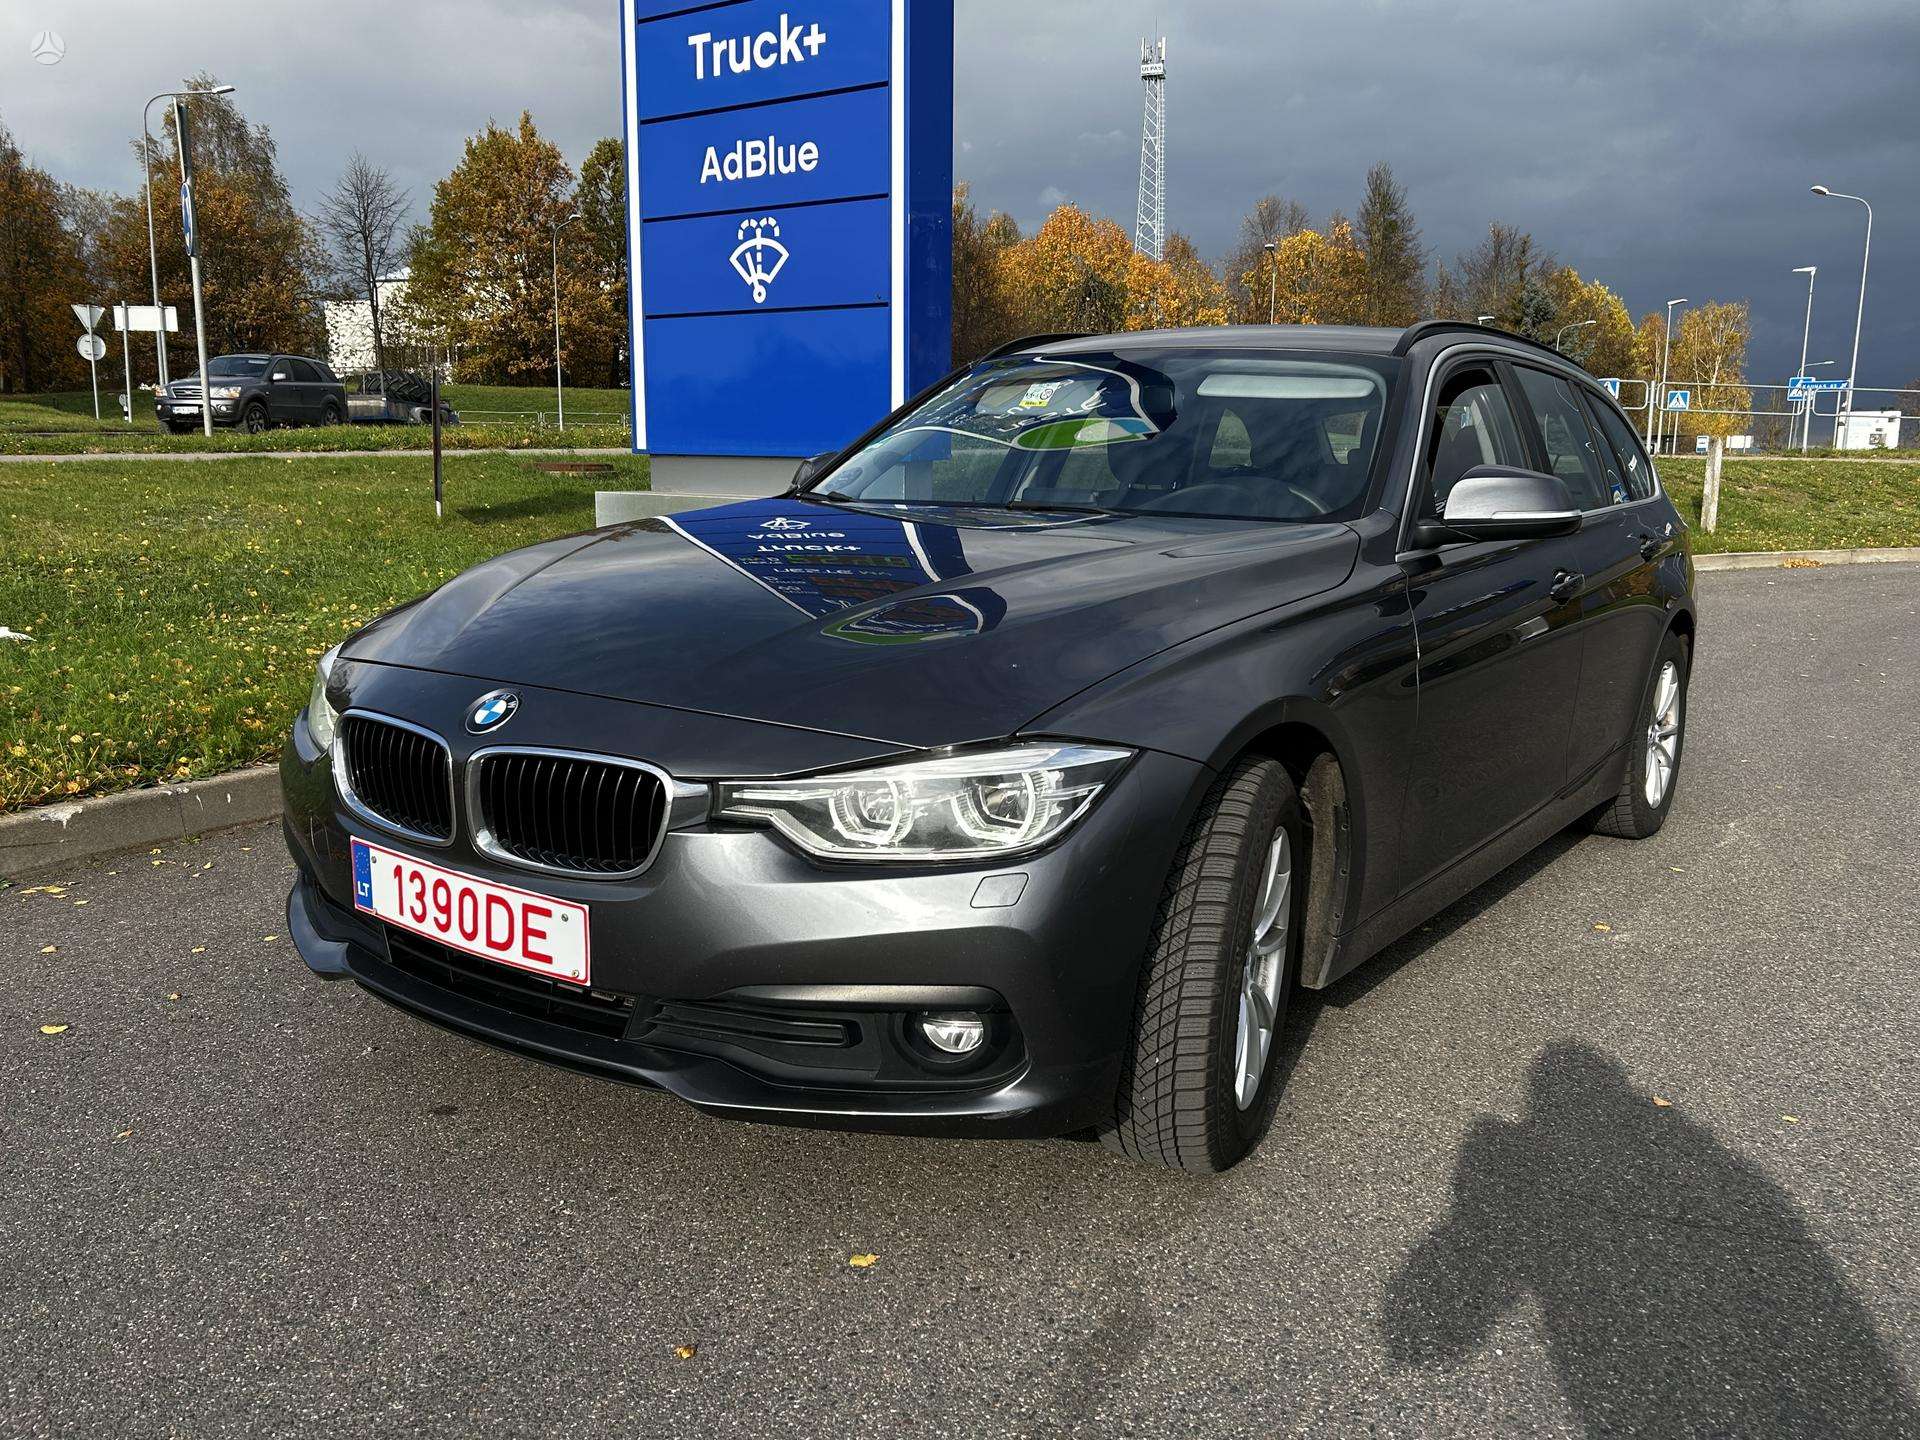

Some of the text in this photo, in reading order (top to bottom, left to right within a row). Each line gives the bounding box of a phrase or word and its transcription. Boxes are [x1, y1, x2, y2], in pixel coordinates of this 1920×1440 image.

[687, 13, 826, 80] Truck+
[700, 135, 819, 184] AdBlue
[357, 881, 370, 898] LT
[393, 864, 553, 965] 1390DE
